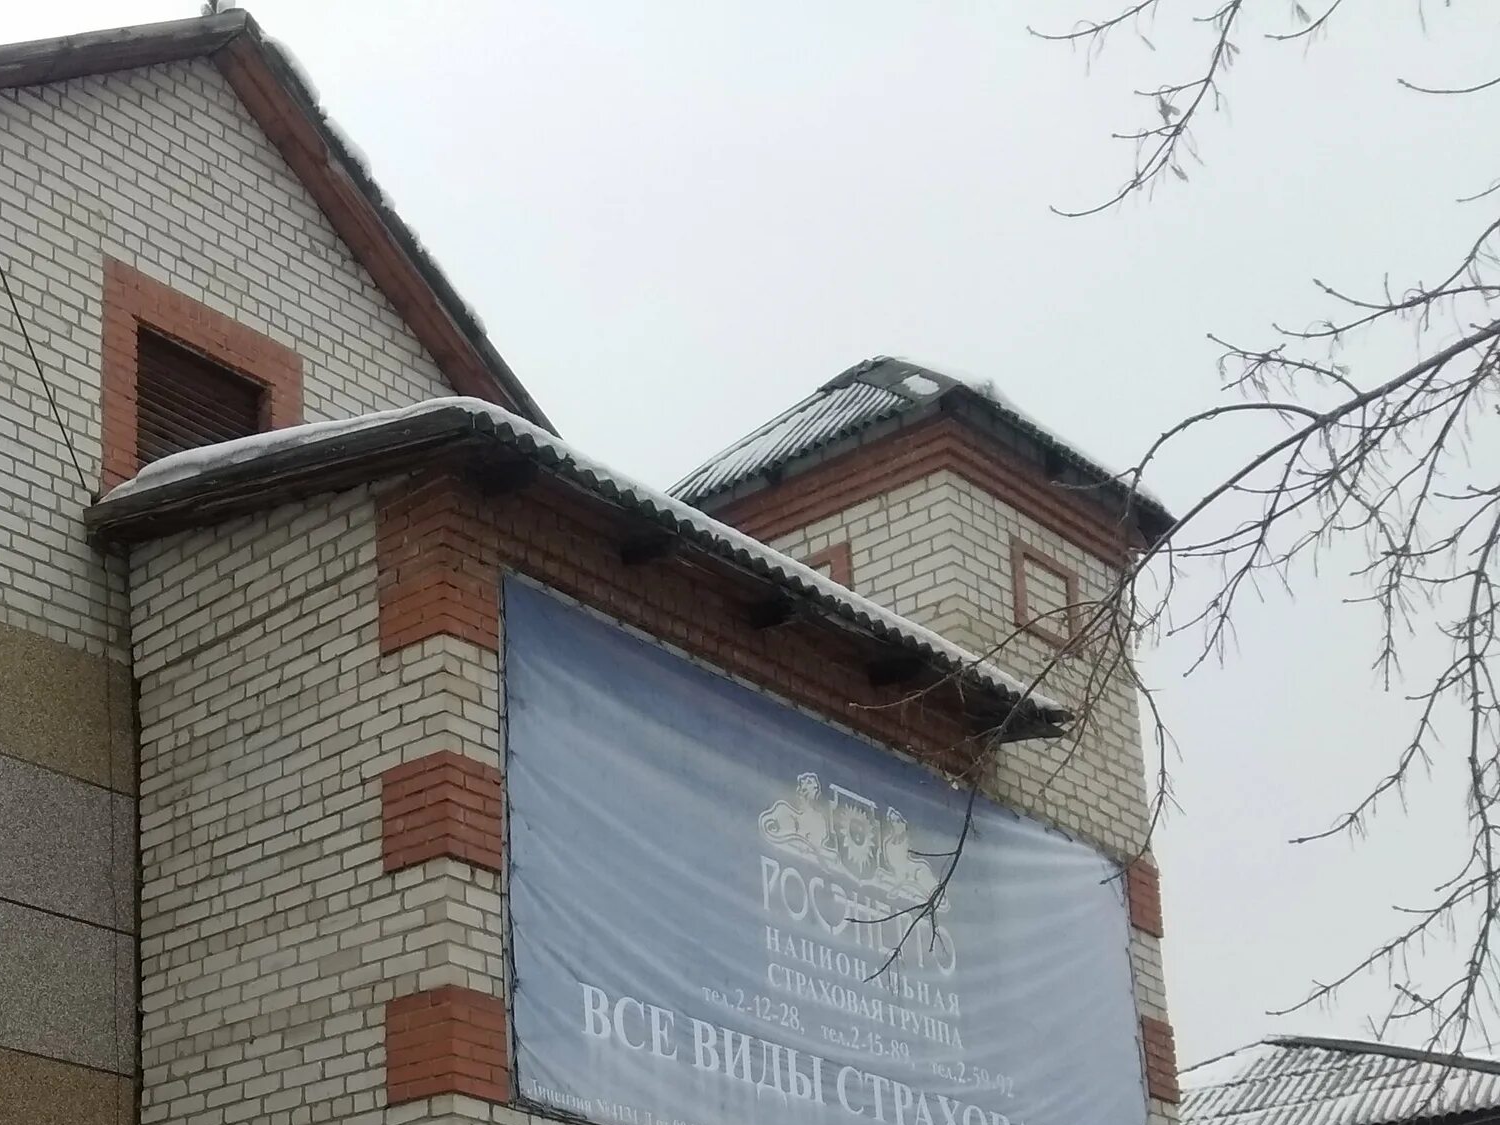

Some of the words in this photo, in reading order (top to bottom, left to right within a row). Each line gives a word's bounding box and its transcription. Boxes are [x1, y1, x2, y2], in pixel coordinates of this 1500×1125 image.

[765, 924, 961, 1017] НАЦИОНАЛЬНАЯ
[767, 962, 884, 1025] СТРАХОВАЯ
[887, 1003, 964, 1050] ГРУППА
[578, 982, 678, 1061] ВСЕ
[687, 1016, 827, 1108] ВИДЫ
